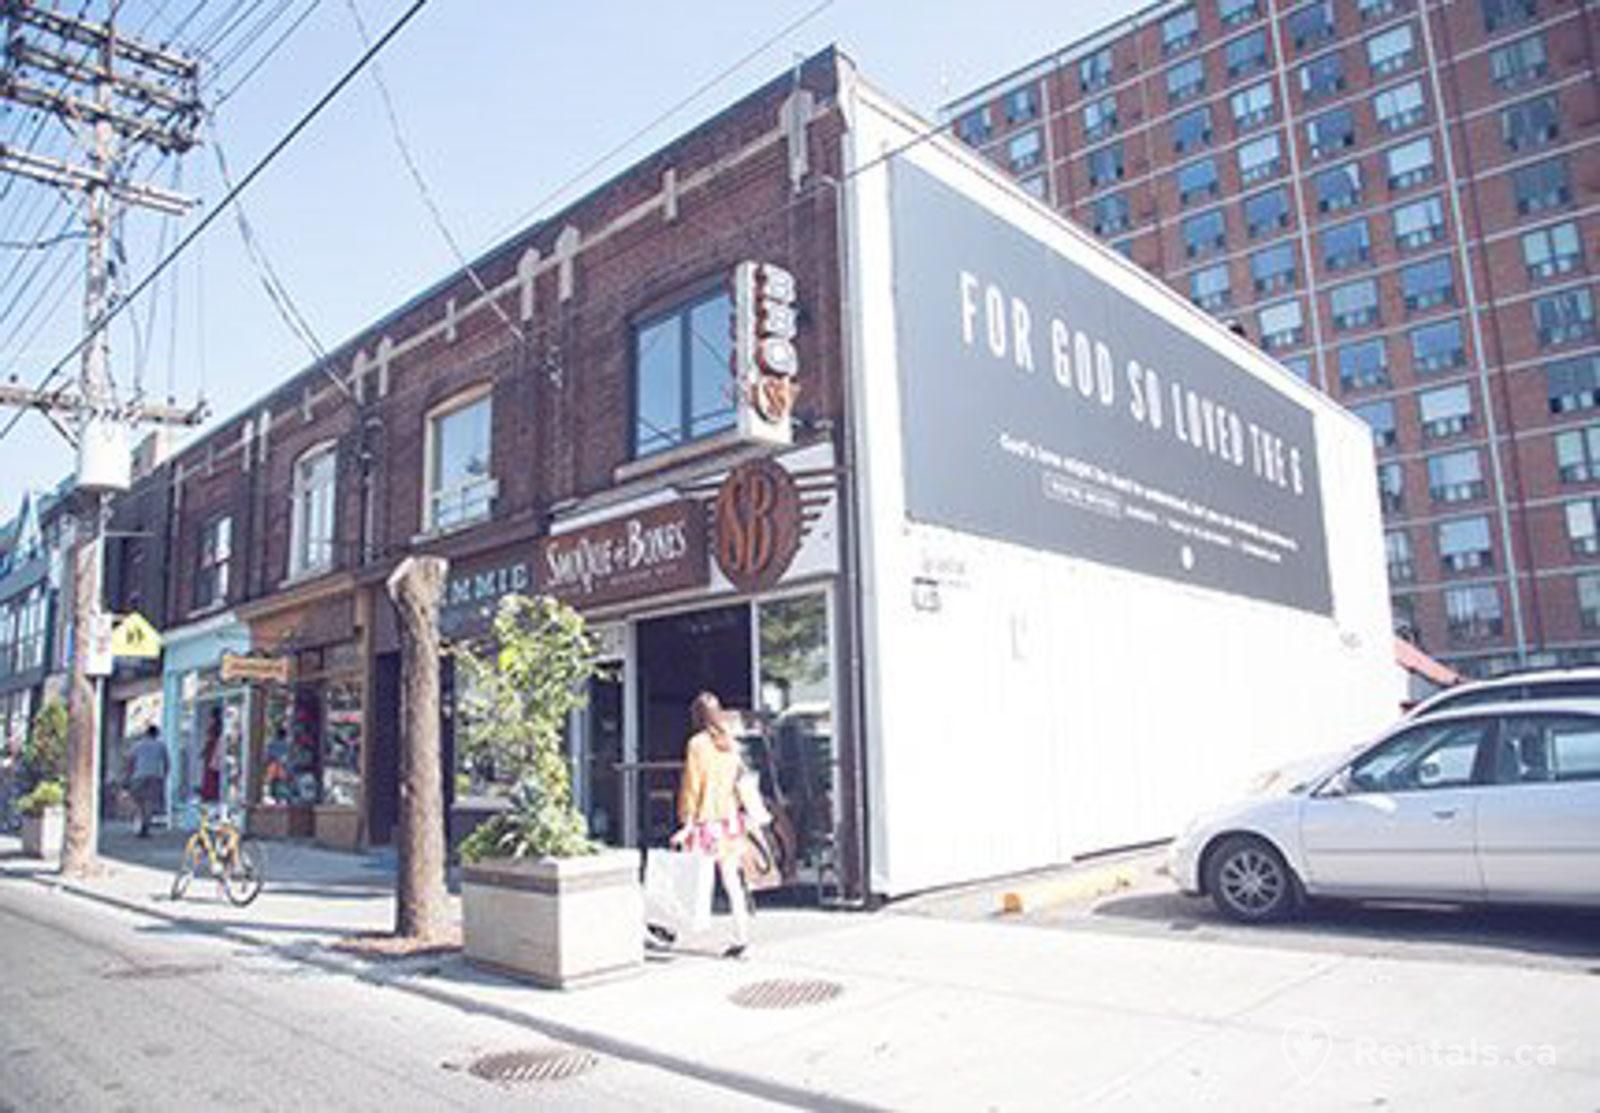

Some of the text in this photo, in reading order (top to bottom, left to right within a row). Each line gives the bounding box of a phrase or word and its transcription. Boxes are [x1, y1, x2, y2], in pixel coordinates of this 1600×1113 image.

[959, 270, 1034, 373] FOR
[1051, 318, 1114, 406] GOD
[1127, 359, 1163, 430] SO
[1171, 382, 1244, 467] LOVED
[1250, 423, 1288, 487] THE
